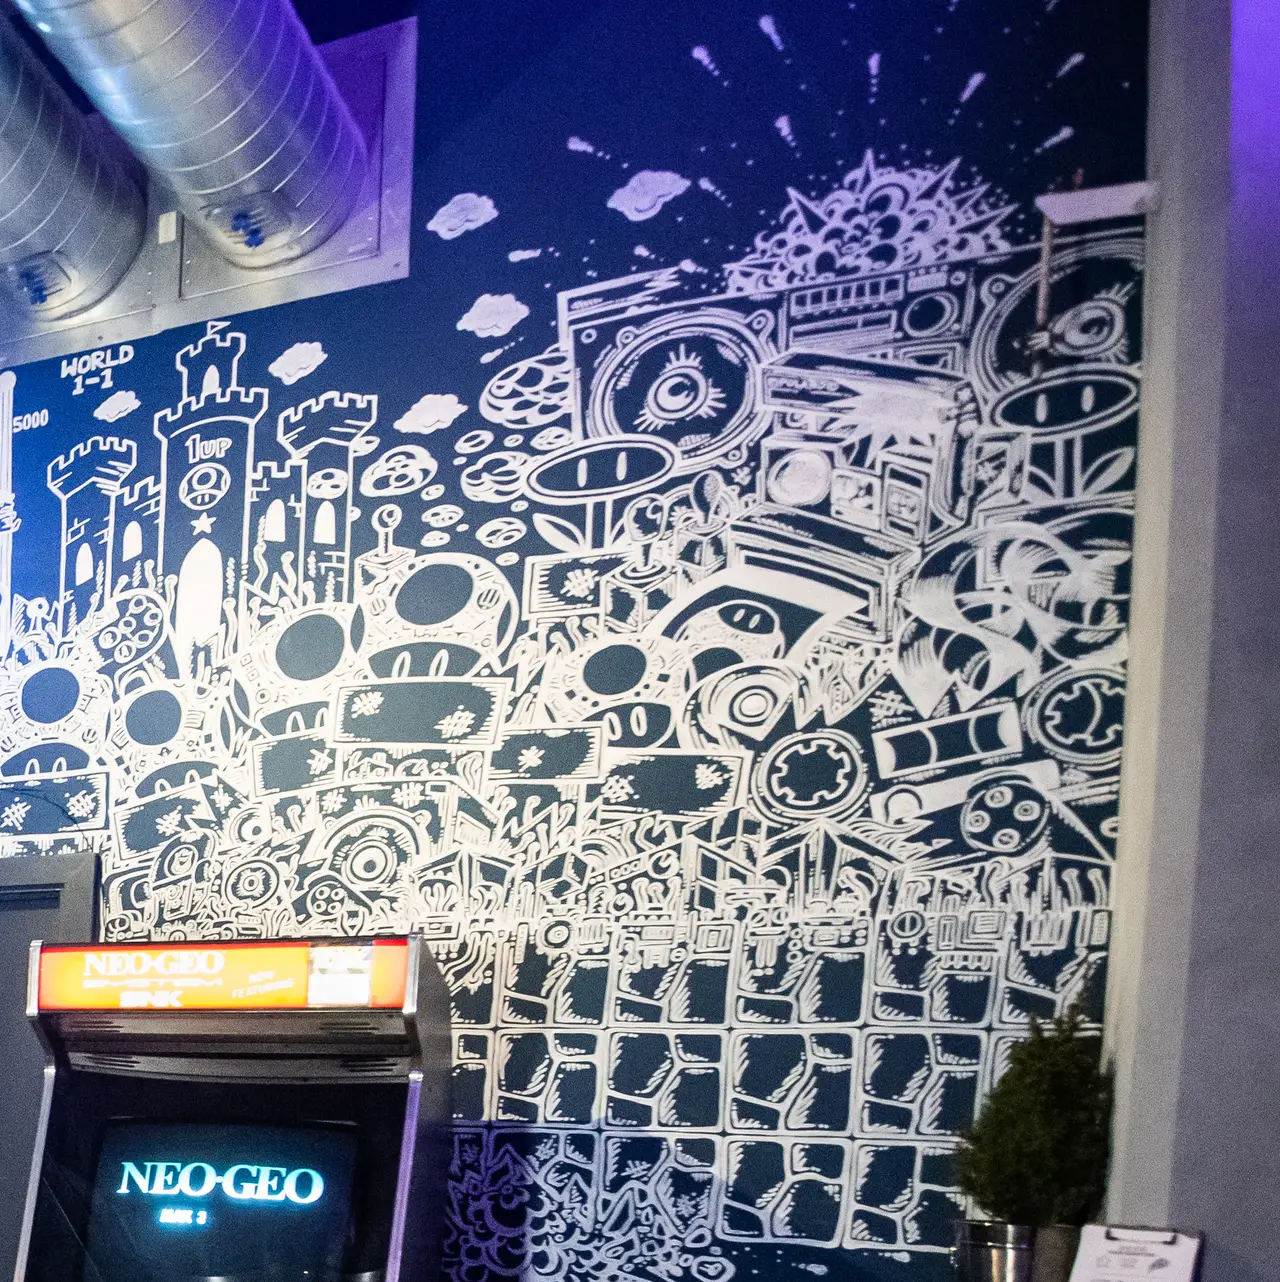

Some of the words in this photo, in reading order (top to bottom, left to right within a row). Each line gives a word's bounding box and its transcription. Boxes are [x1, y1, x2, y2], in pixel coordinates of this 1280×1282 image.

[60, 345, 135, 379] WORLD
[71, 368, 114, 396] 1-1
[12, 408, 49, 433] 5000
[118, 989, 184, 1008] SNK
